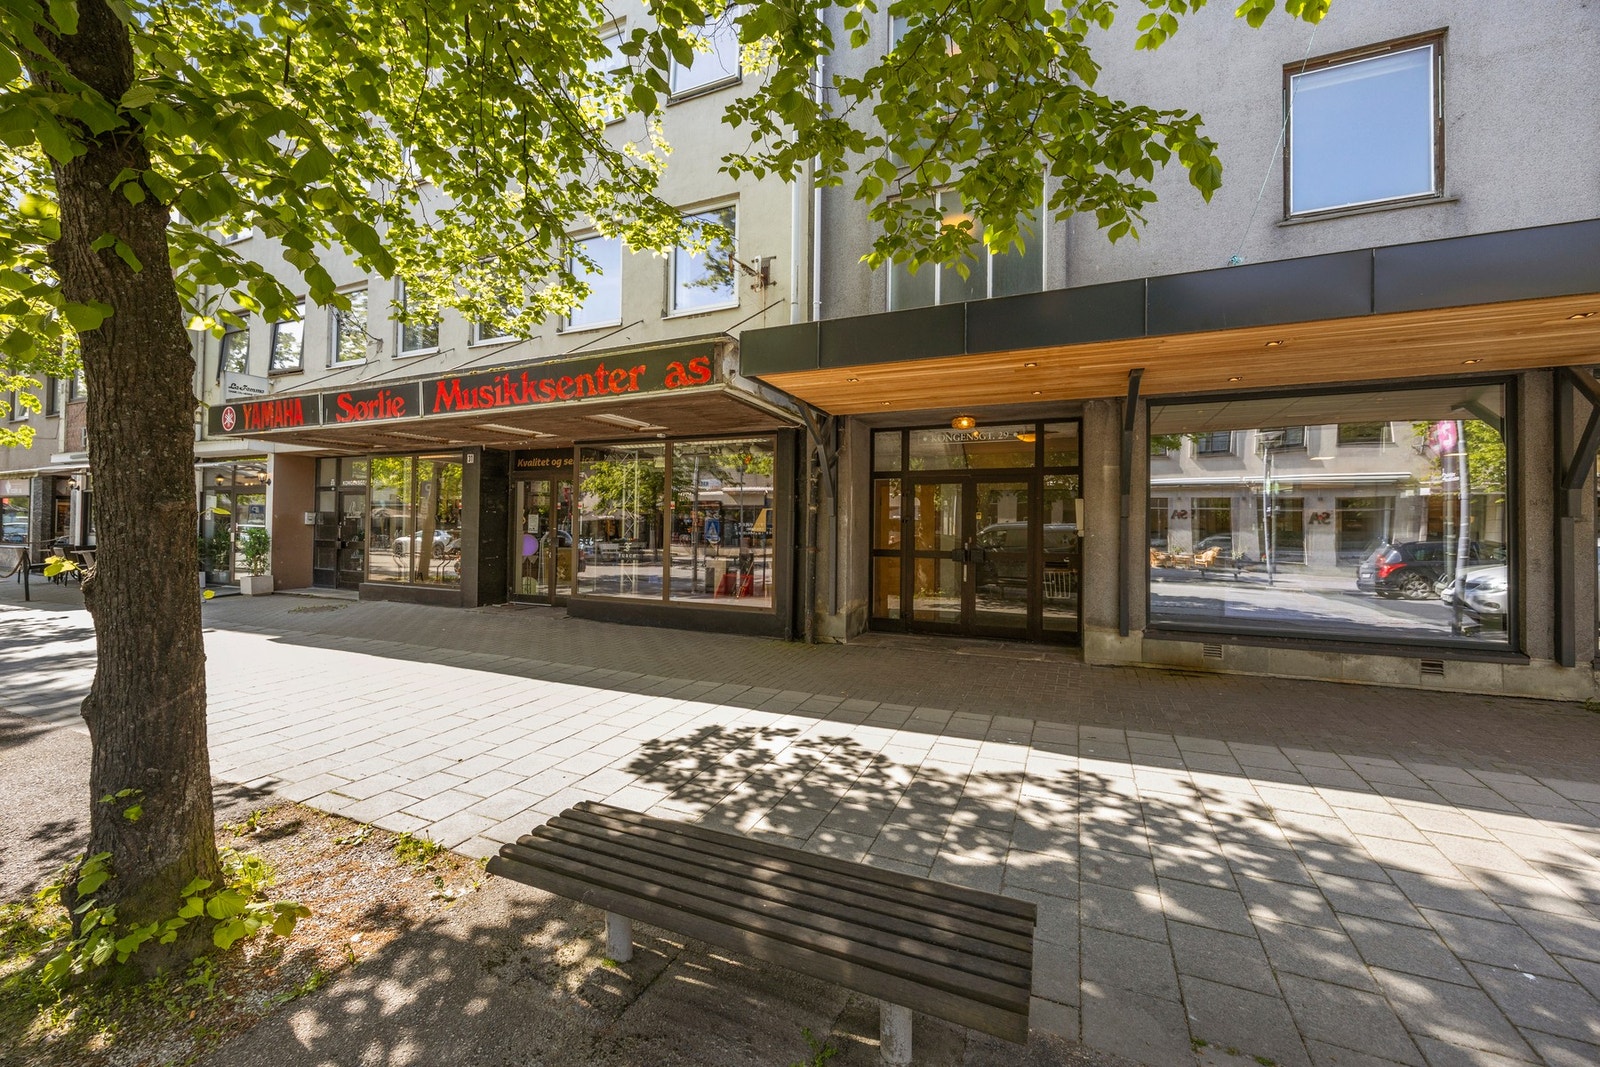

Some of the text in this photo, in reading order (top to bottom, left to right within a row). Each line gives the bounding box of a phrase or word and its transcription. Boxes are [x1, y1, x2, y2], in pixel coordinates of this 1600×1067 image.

[432, 356, 713, 413] Musikksenter as
[243, 397, 304, 431] YAMAHA
[336, 389, 406, 423] Sørlie
[998, 431, 1009, 440] 29
[517, 457, 550, 467] Kvalitet
[551, 459, 562, 468] og
